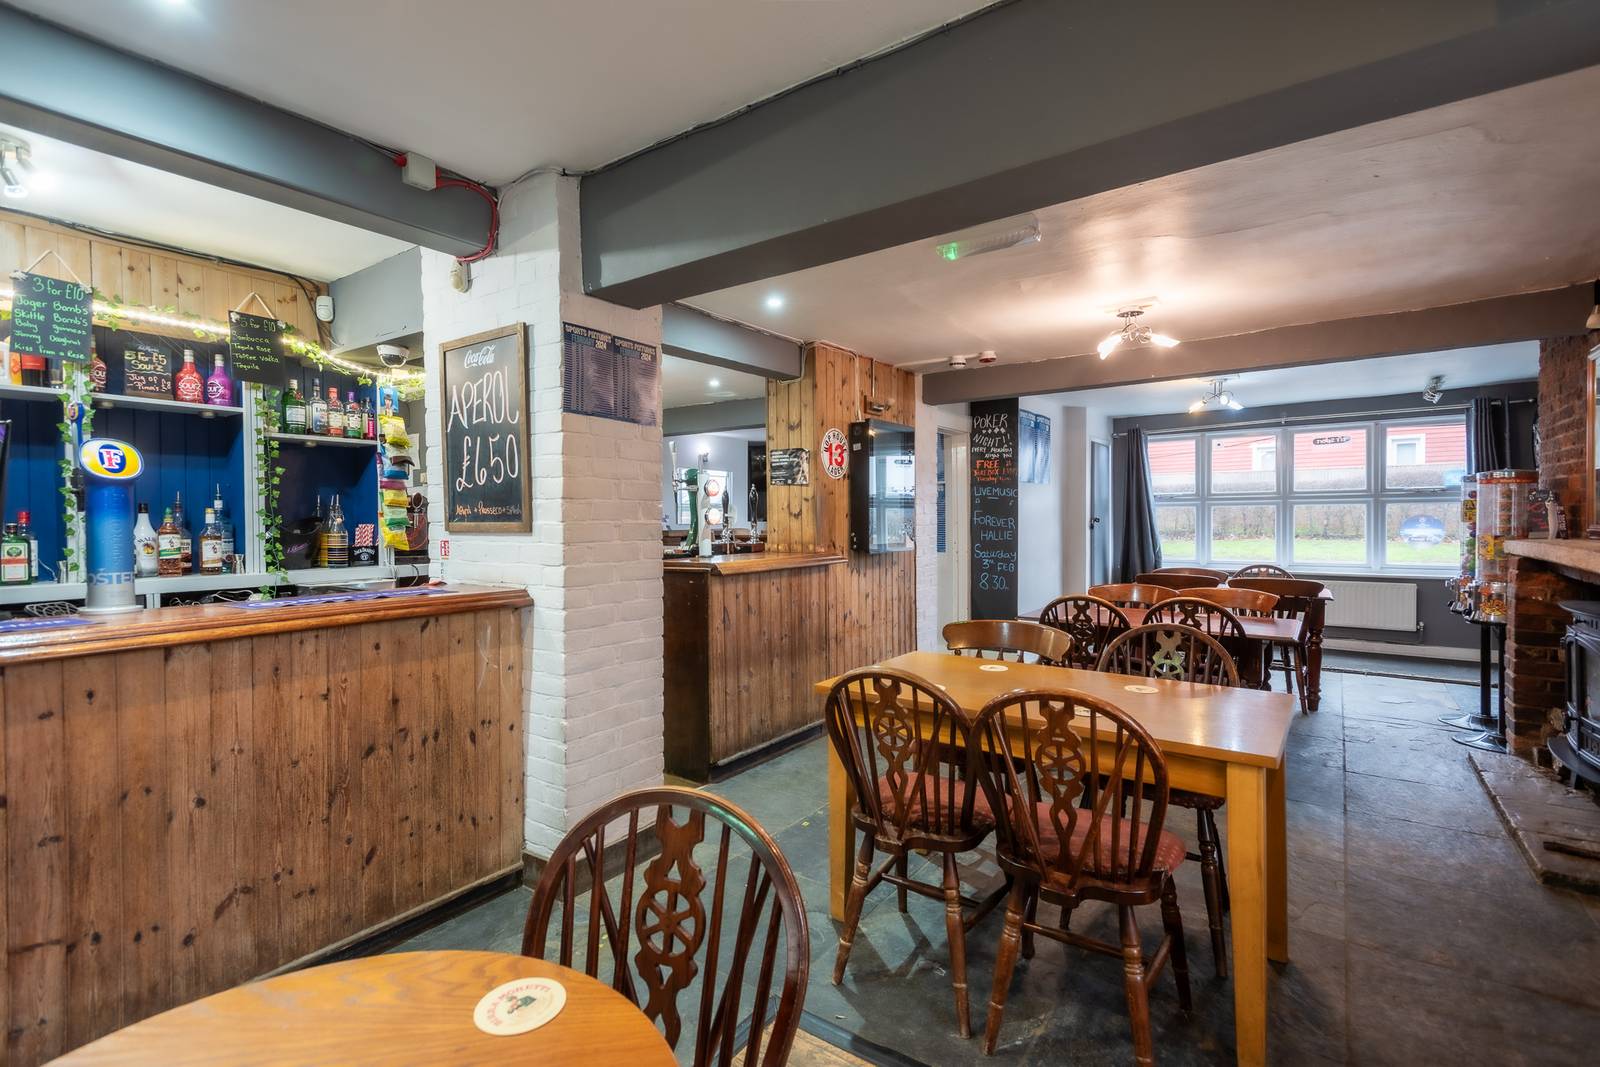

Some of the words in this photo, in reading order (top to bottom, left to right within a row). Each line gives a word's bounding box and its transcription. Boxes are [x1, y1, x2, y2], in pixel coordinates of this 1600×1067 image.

[32, 276, 45, 292] 3
[47, 280, 62, 295] for
[65, 283, 84, 300] £10
[595, 340, 607, 351] 2024
[447, 366, 519, 433] APEROL
[973, 413, 1009, 429] POKER
[827, 442, 845, 467] 13
[827, 464, 844, 475] LAGER
[976, 460, 1000, 469] FREE
[974, 487, 992, 497] LIVE
[992, 488, 1018, 498] MUSIC
[980, 530, 1013, 541] HALLIE
[974, 544, 1017, 562] Saturday
[997, 562, 1015, 572] FEB
